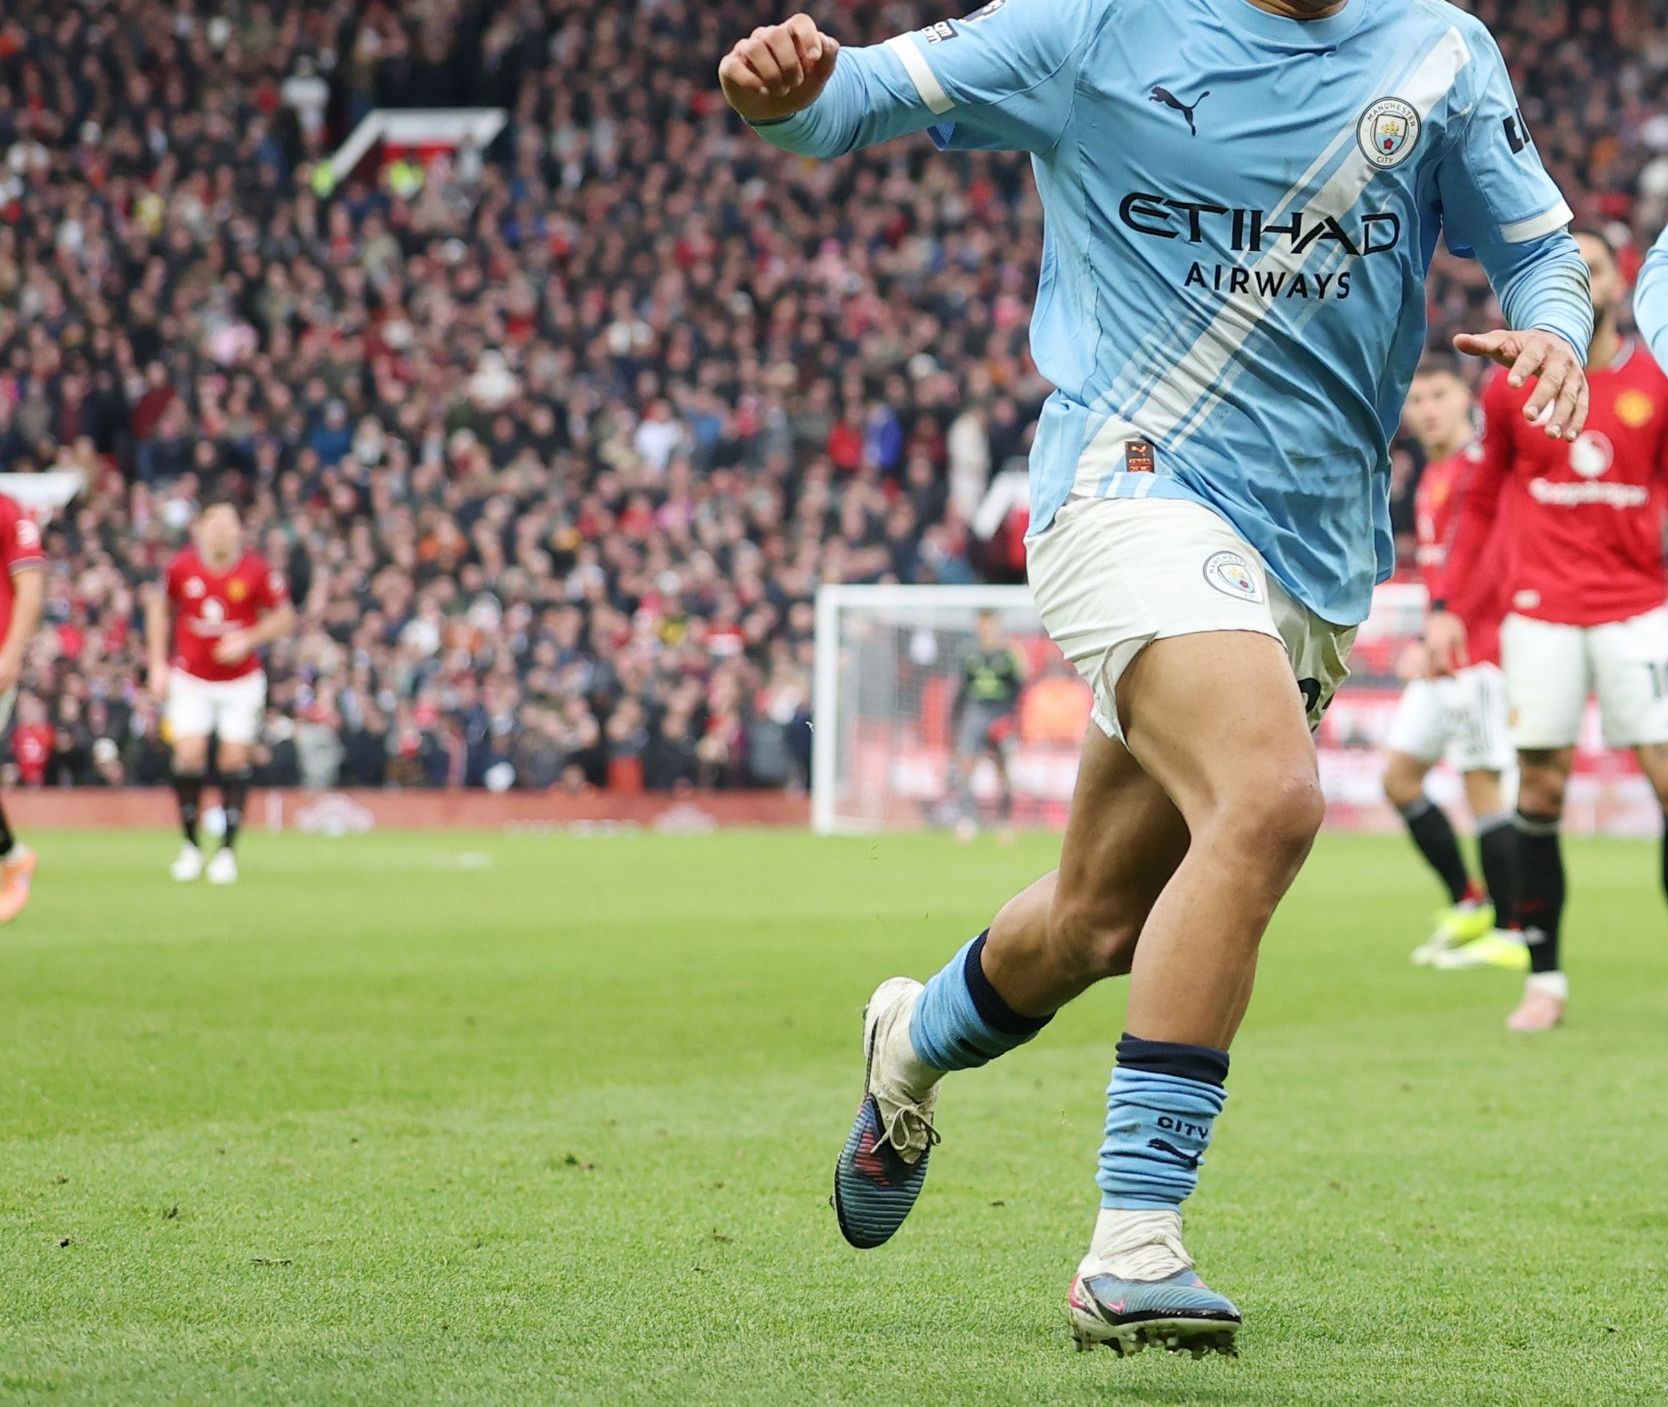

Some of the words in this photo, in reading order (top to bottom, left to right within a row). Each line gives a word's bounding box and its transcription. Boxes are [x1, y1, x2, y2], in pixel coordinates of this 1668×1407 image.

[1366, 102, 1417, 128] MANCHESTER
[1376, 155, 1395, 164] CITY
[1118, 191, 1401, 257] ETIHAD
[1183, 261, 1351, 299] AIRWAYS
[1157, 1116, 1209, 1139] CITY
